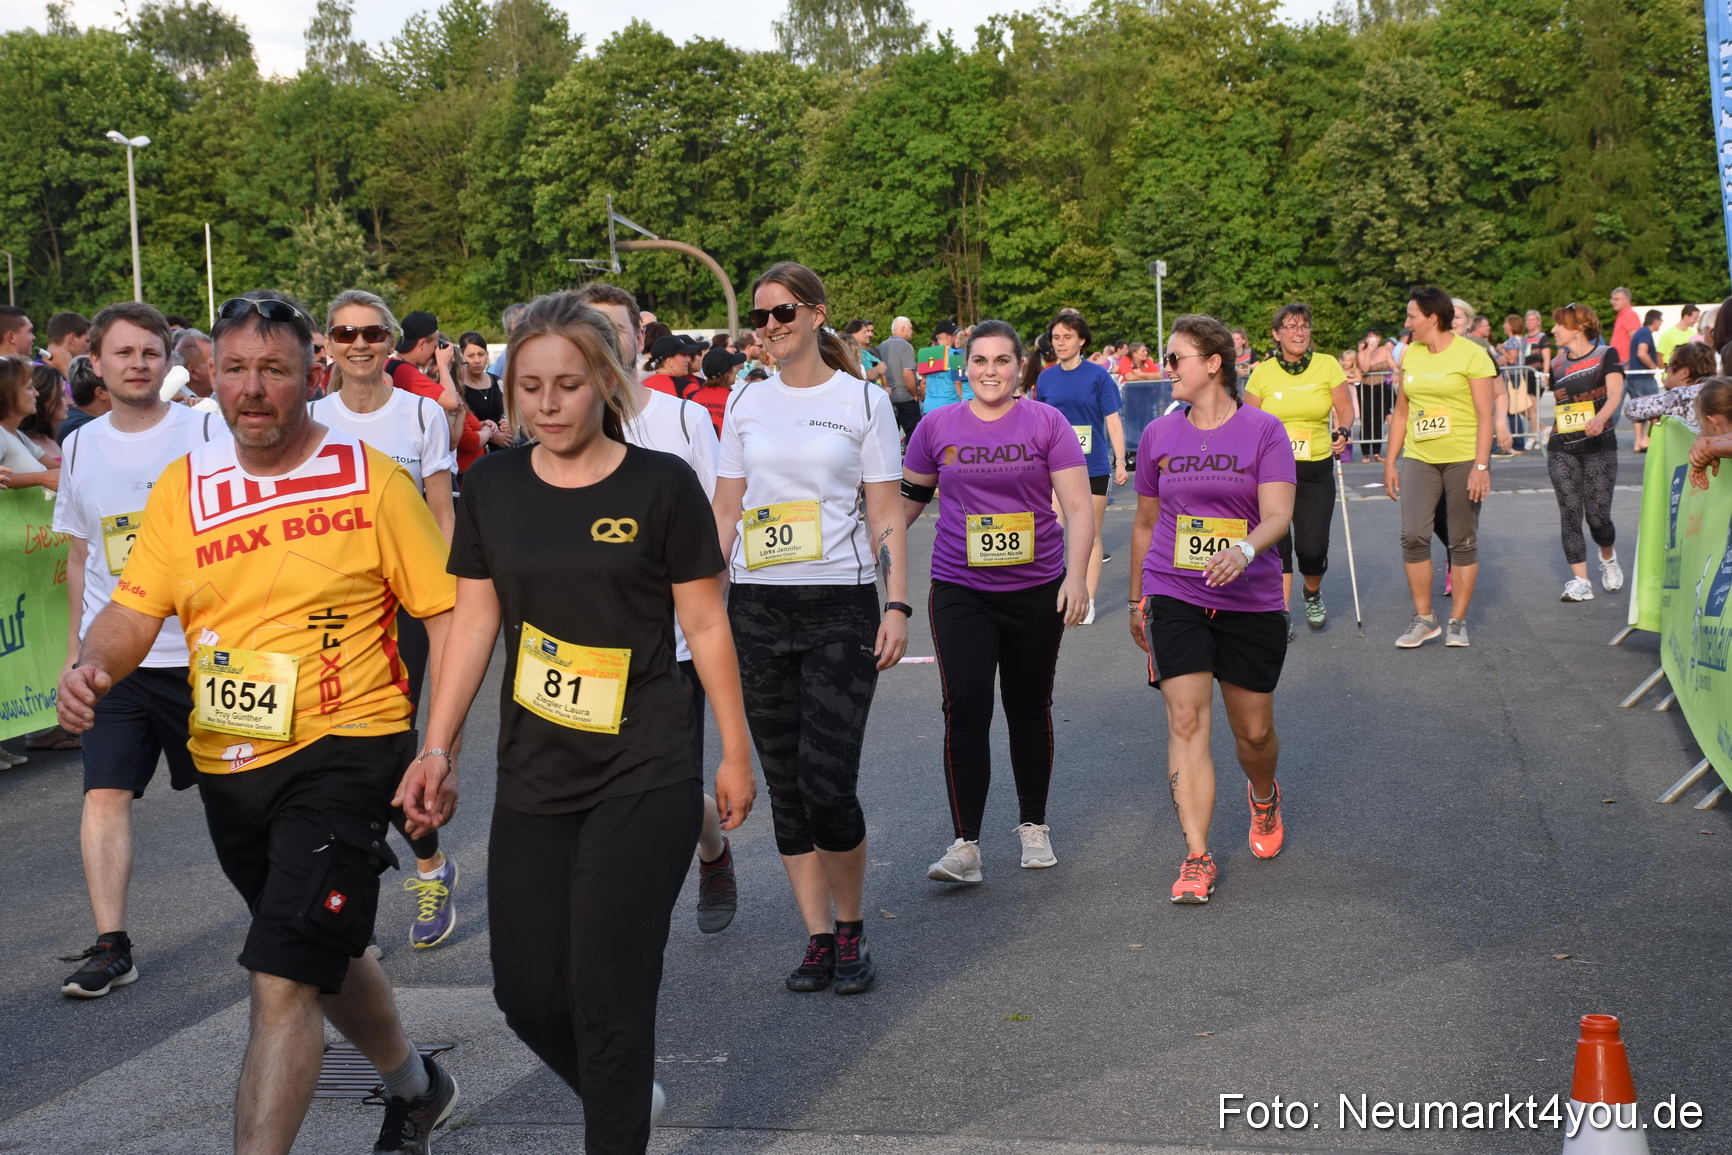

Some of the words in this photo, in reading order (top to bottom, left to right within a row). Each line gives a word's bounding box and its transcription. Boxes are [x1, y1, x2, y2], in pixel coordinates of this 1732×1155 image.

[1416, 417, 1446, 432] 1242
[1565, 412, 1586, 425] 971
[809, 419, 853, 434] auctore
[1079, 436, 1087, 447] 2
[1290, 440, 1306, 451] 07
[957, 444, 1035, 465] GRADL
[957, 466, 1036, 474] HOLZKREATIONEN
[1167, 453, 1245, 474] GRADL
[1166, 475, 1245, 484] HOLZKREATIONEN
[195, 524, 272, 569] MAX
[282, 507, 373, 542] BÖGL
[765, 523, 793, 548] 30
[981, 532, 1021, 552] 938
[777, 545, 802, 554] Jennifer
[1189, 536, 1230, 556] 940
[0, 593, 26, 652] uf
[544, 668, 582, 705] 81
[206, 677, 278, 715] 1654
[536, 693, 562, 710] Ziegler
[565, 704, 591, 717] Laura
[215, 709, 230, 720] Pruy
[232, 711, 263, 723] Günther
[572, 714, 592, 723] GmbH
[227, 719, 254, 729] Bauservice
[255, 723, 273, 731] GmbH
